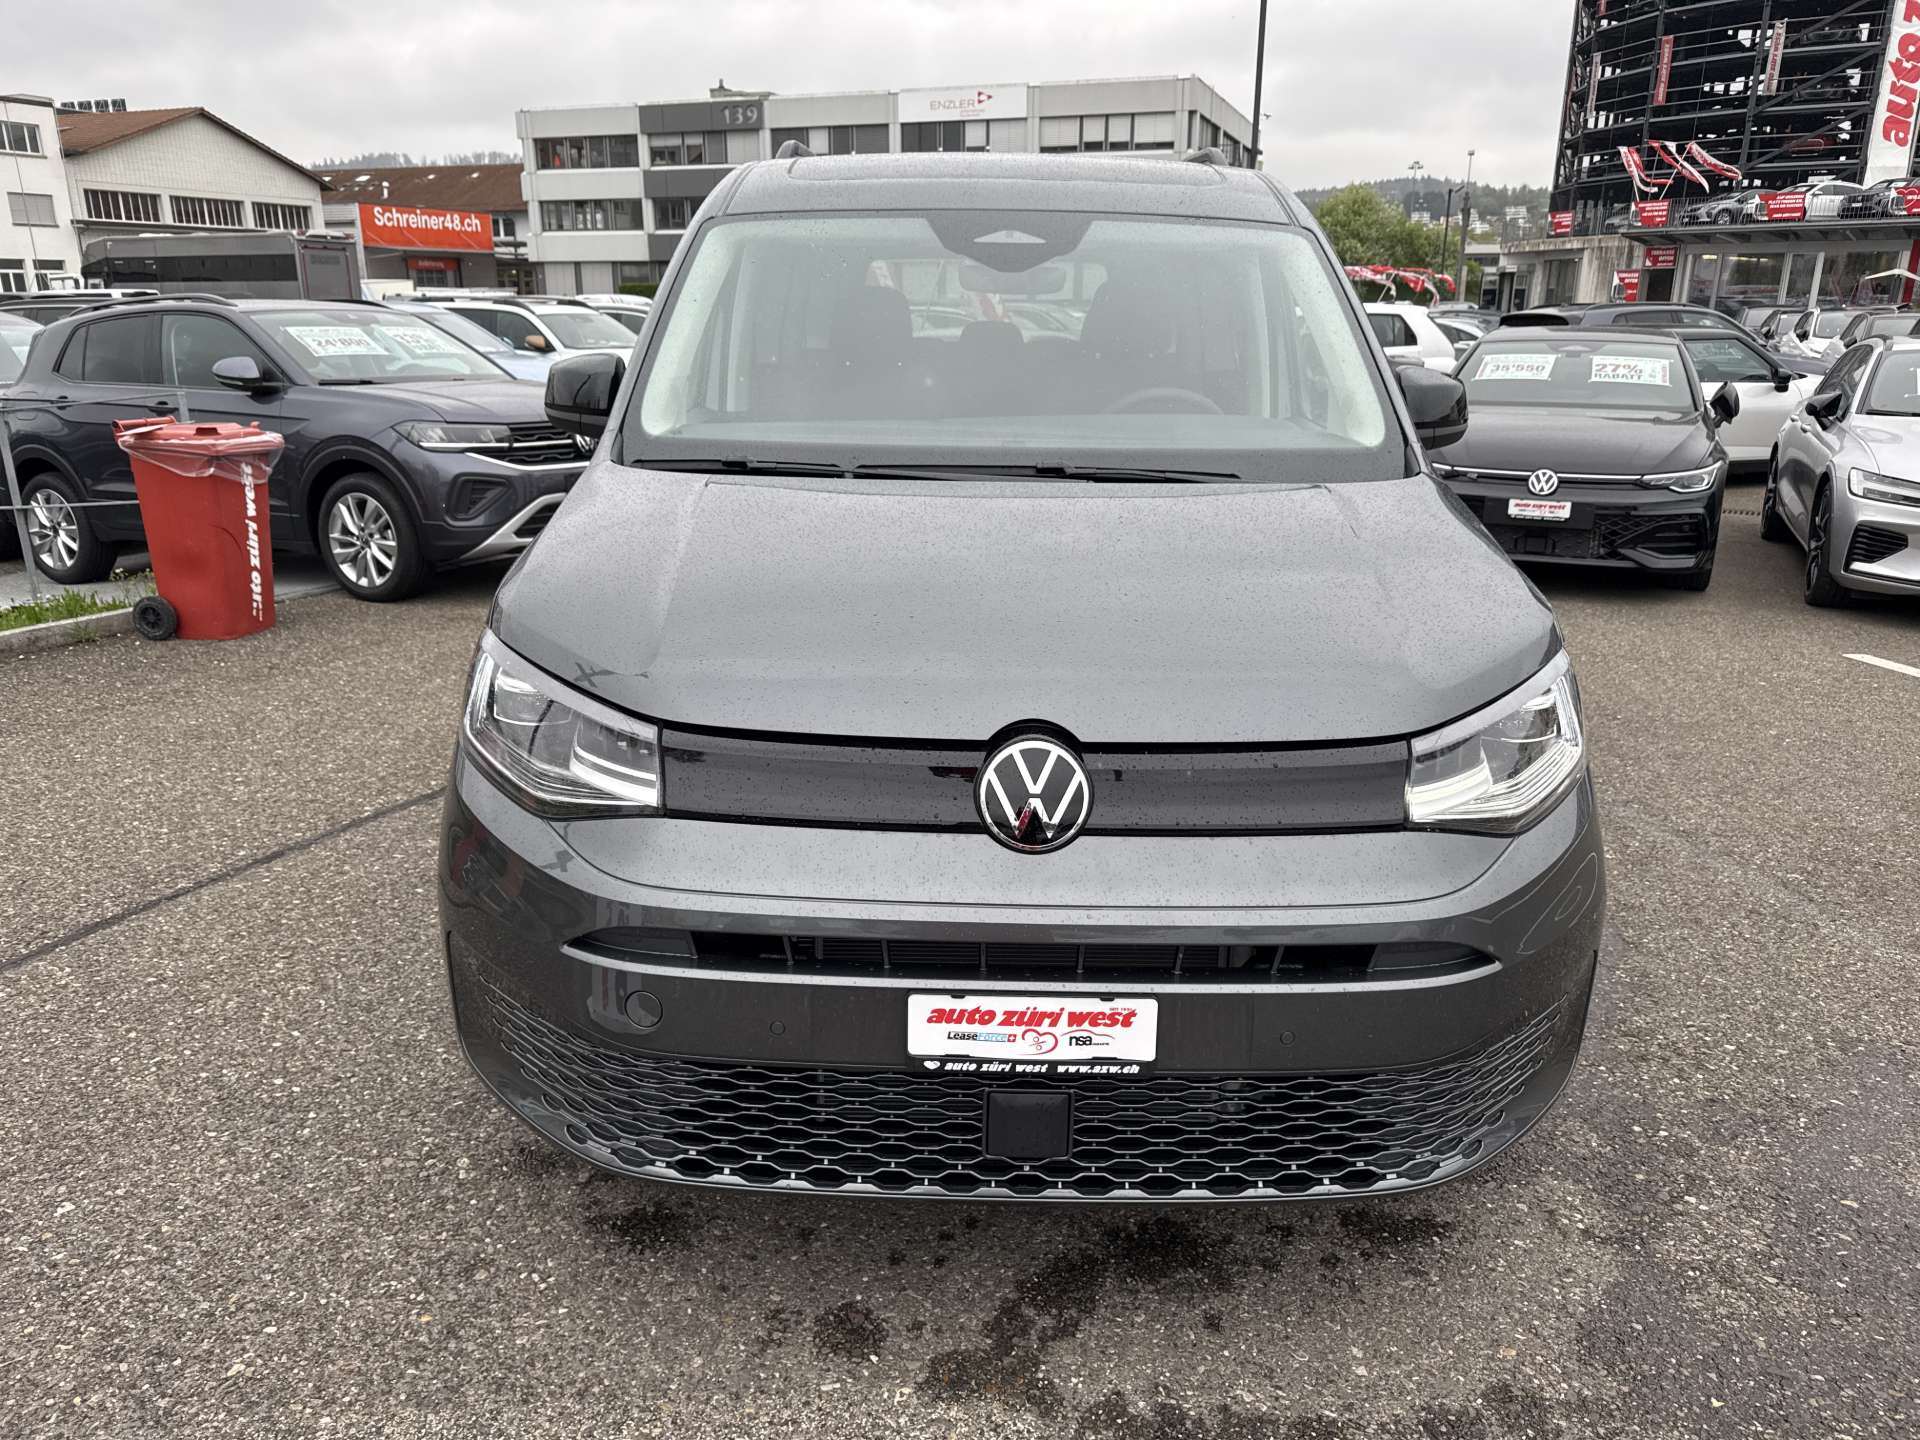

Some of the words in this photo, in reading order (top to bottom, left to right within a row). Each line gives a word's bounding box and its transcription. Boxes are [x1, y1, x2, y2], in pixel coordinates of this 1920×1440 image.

[1882, 32, 1920, 147] auto
[721, 104, 758, 125] 139
[929, 98, 976, 111] ENZLER
[373, 206, 482, 233] Schreiner48.ch
[1594, 363, 1643, 374] 27%
[240, 463, 257, 517] west
[244, 518, 261, 571] züri
[926, 1005, 996, 1027] auto
[997, 1006, 1065, 1028] züri
[1067, 1008, 1138, 1028] west
[1069, 1035, 1093, 1047] nsa
[944, 1061, 977, 1072] auto
[980, 1062, 1012, 1073] züri
[1015, 1063, 1049, 1073] west
[1057, 1064, 1141, 1075] www.azw.ch
